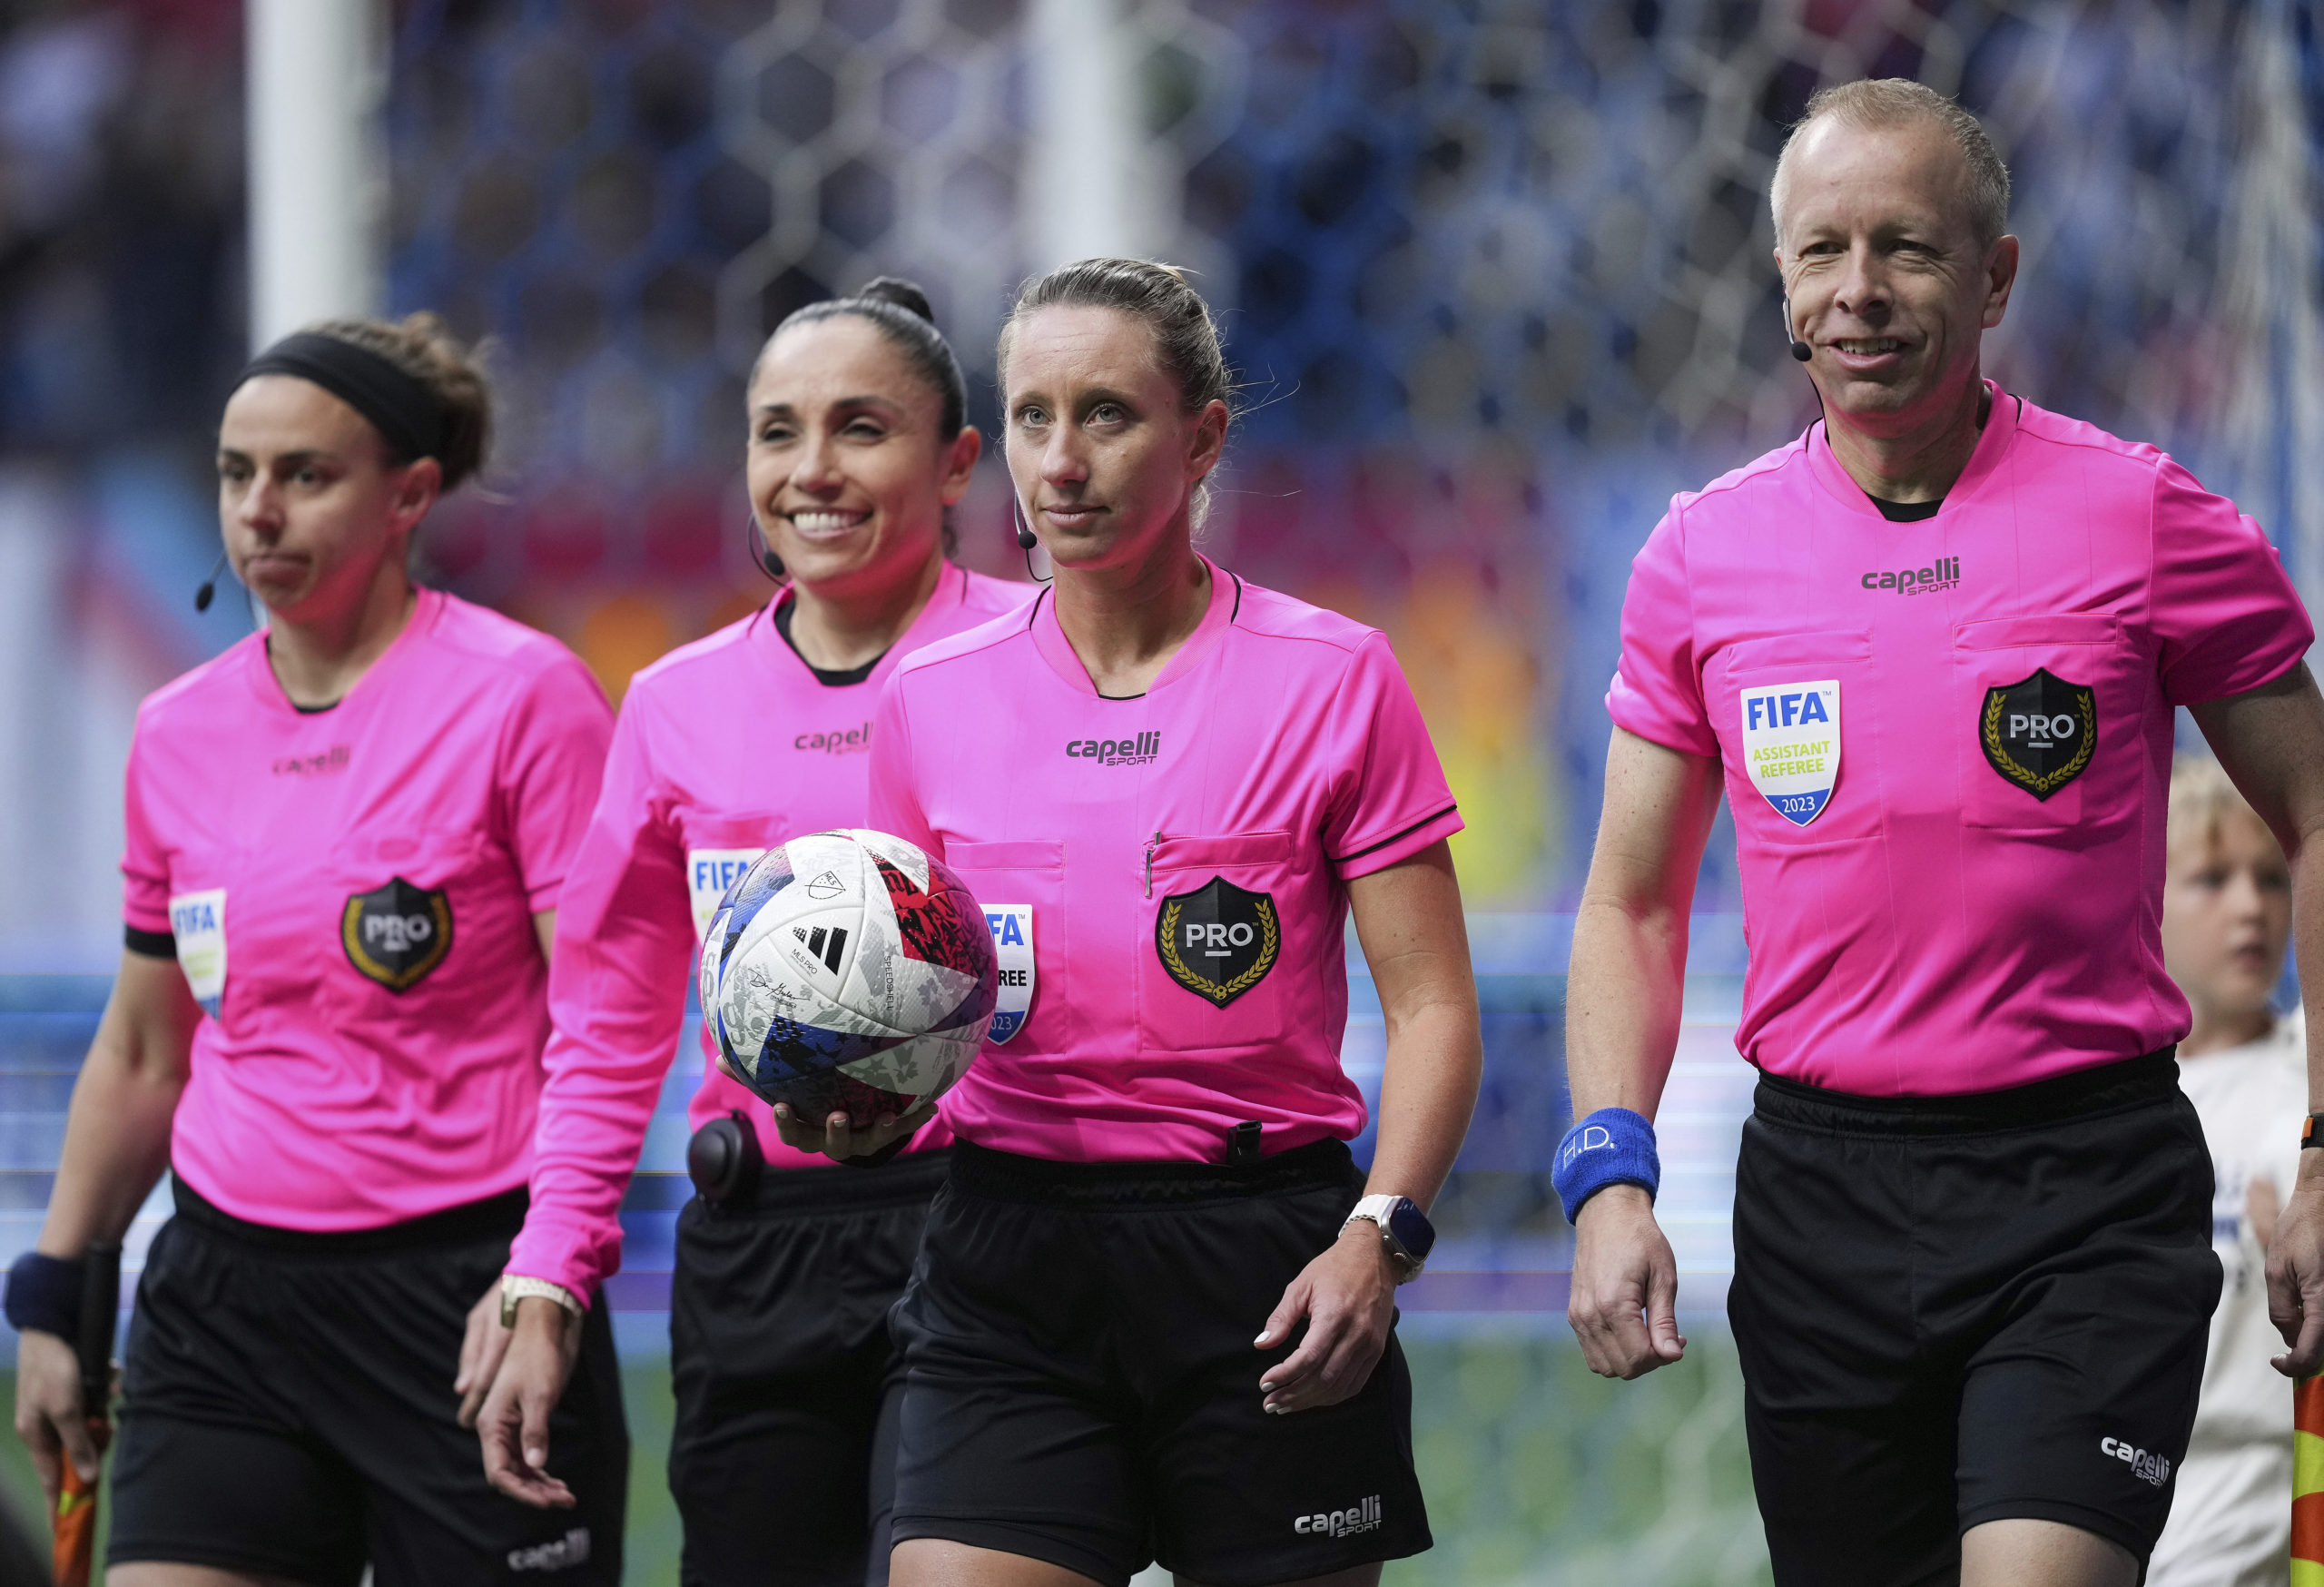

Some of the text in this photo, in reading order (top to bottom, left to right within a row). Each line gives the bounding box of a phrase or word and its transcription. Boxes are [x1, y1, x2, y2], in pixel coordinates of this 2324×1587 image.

[1862, 557, 1959, 594] capelli
[1907, 581, 1959, 596] SPORT
[1748, 692, 1828, 730] FIFA
[795, 723, 869, 753] capel
[2010, 715, 2074, 738] PRO
[1067, 731, 1160, 764] capelli
[1753, 740, 1830, 762] ASSISTANT
[1107, 756, 1157, 766] SPORT
[1760, 757, 1825, 778] REFEREE
[1782, 796, 1815, 813] 2023
[365, 914, 431, 942] PRO
[986, 914, 1024, 945] FA
[1186, 922, 1253, 947] PRO
[792, 949, 805, 962] MLS
[804, 961, 817, 974] PRO
[884, 956, 894, 1010] SPEEDSHELL
[991, 1017, 1011, 1030] 023
[2101, 1436, 2170, 1484] capelli
[2135, 1468, 2163, 1488] SPOR
[1295, 1494, 1382, 1537] capelli
[1337, 1520, 1382, 1538] SPORT
